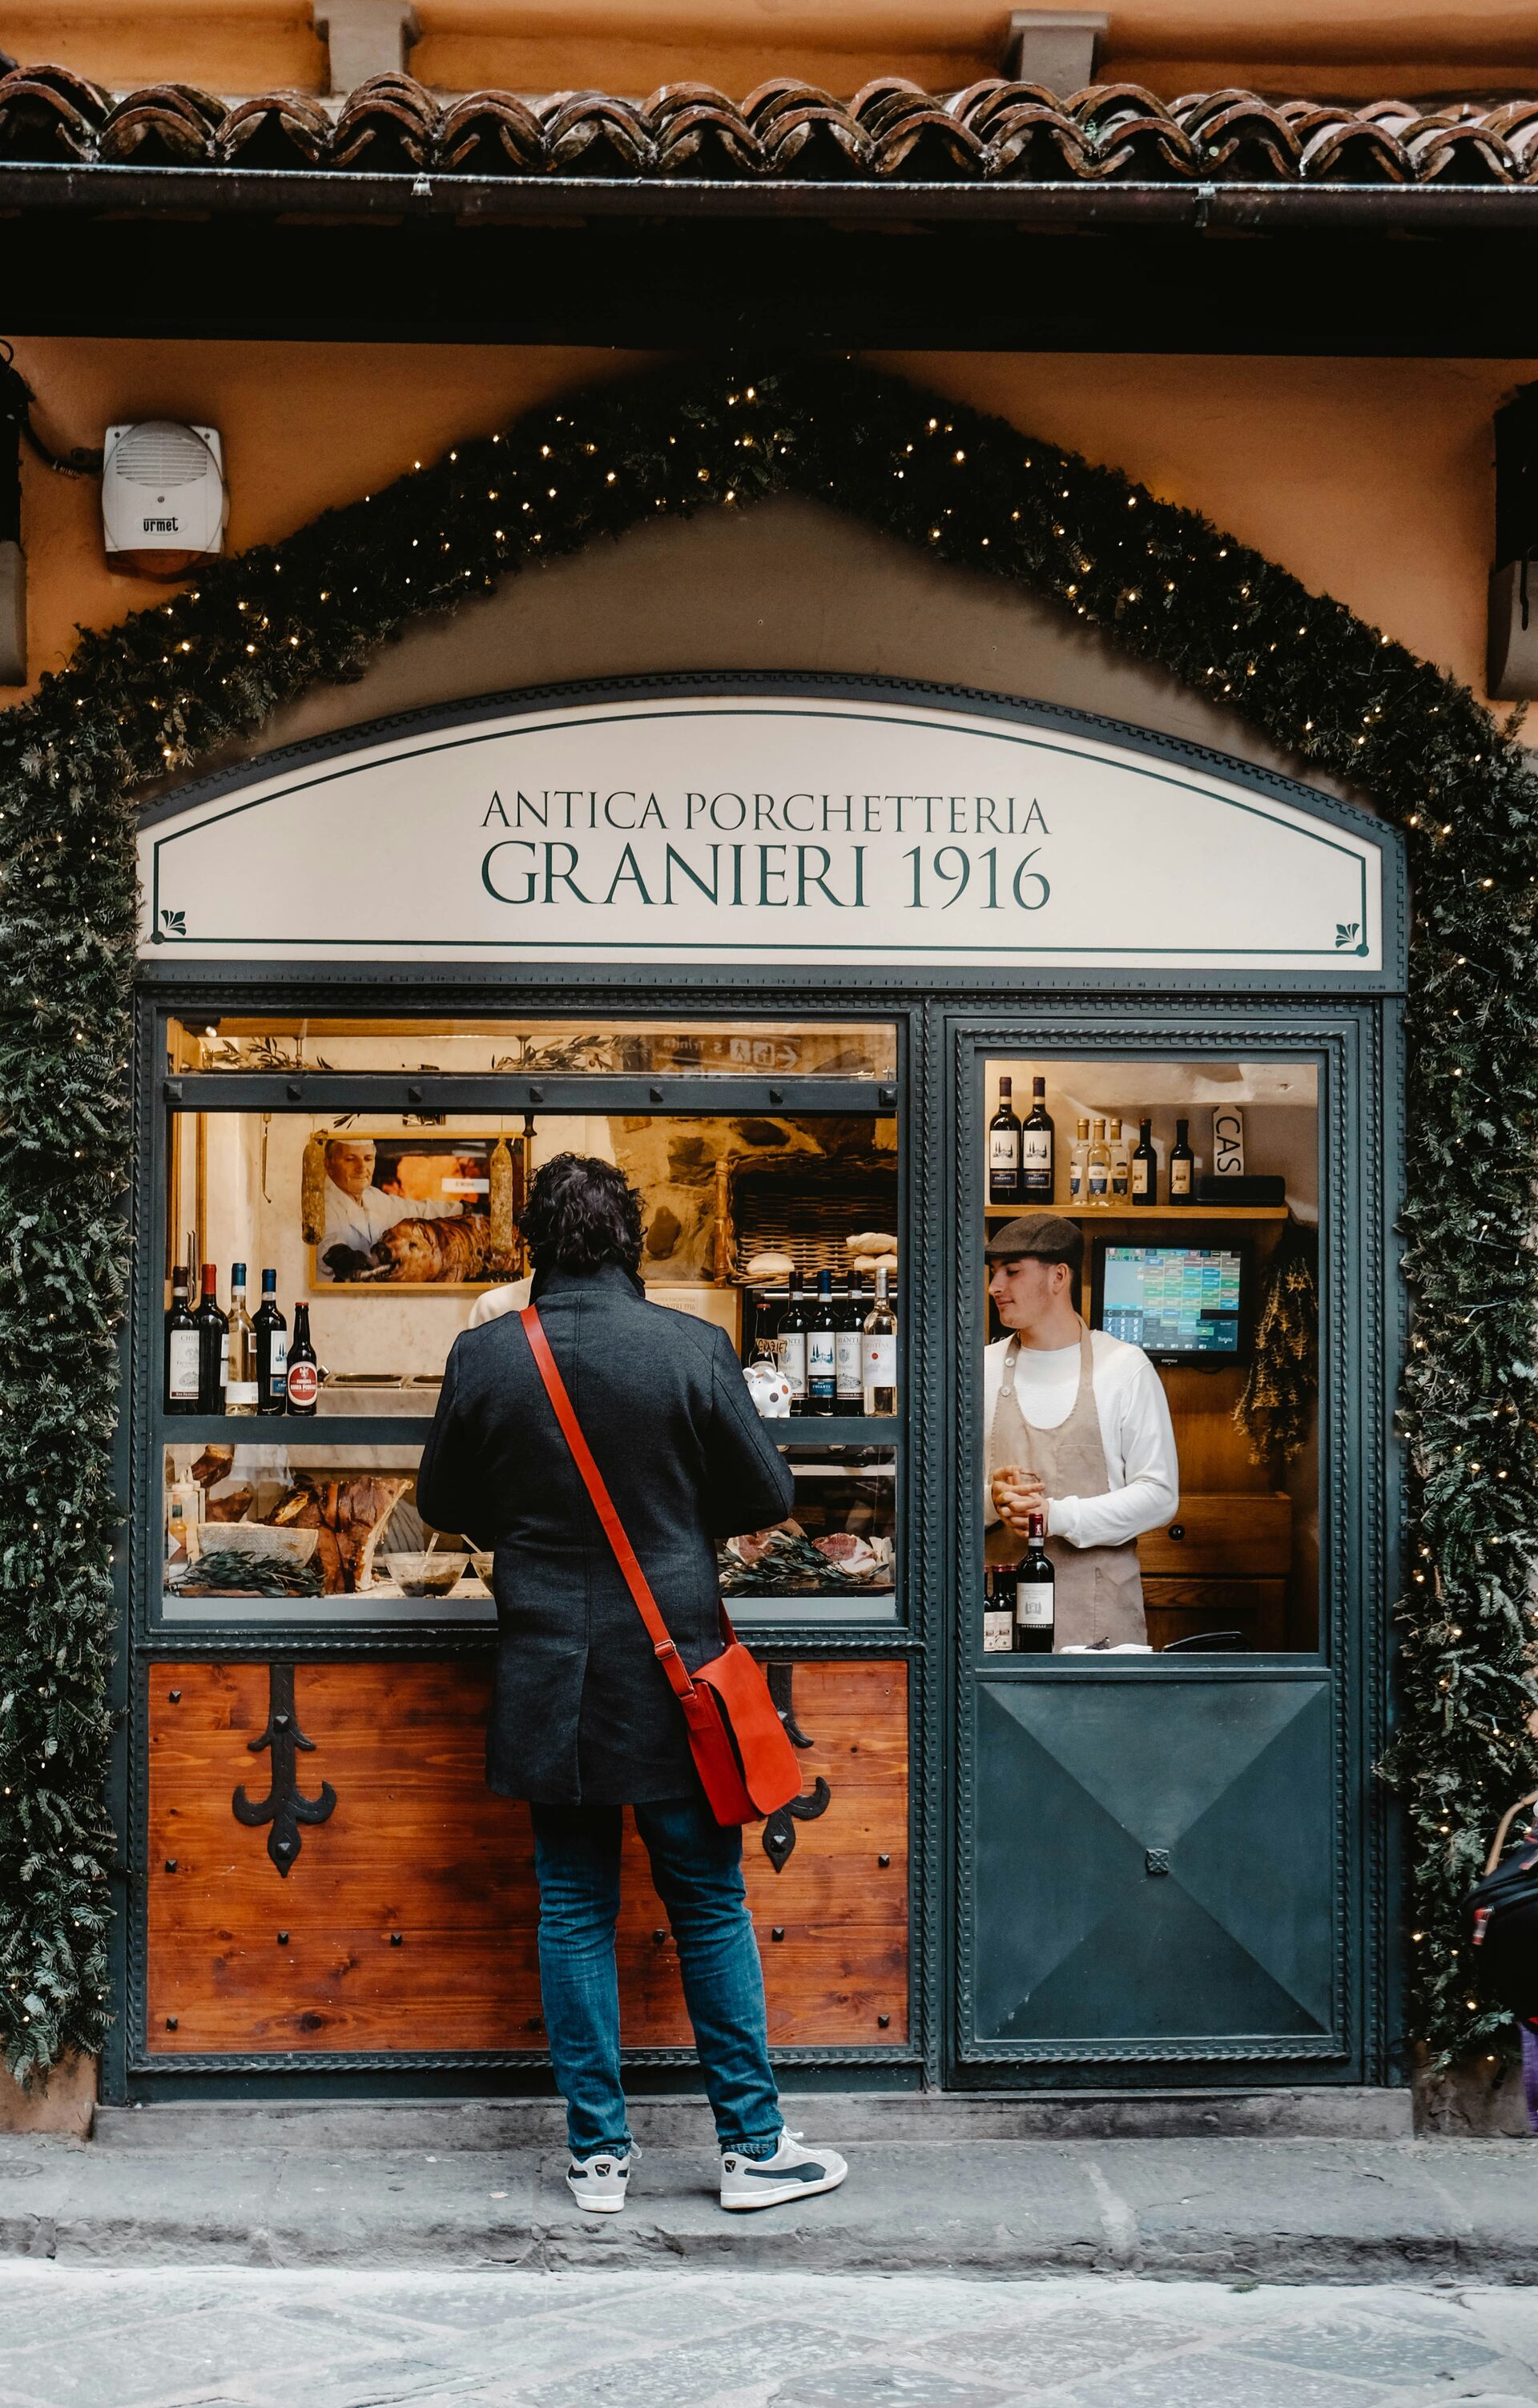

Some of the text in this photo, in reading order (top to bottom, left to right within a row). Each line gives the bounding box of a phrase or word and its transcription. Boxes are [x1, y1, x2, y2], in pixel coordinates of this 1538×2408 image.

[143, 517, 179, 533] urmet
[481, 790, 1052, 835] ANTICA PORCHETTERIA
[481, 840, 1051, 911] GRANIERI 1916
